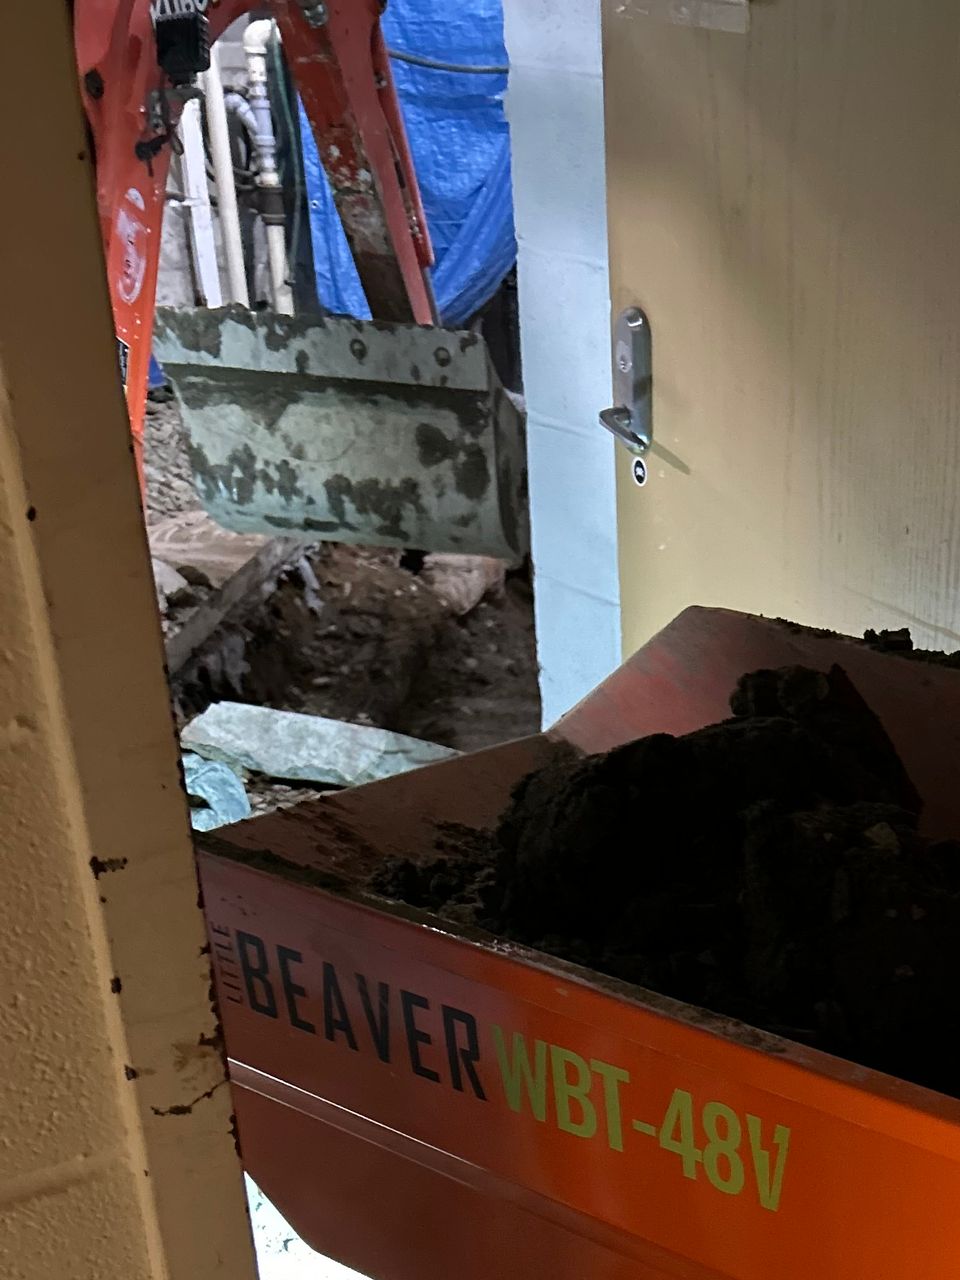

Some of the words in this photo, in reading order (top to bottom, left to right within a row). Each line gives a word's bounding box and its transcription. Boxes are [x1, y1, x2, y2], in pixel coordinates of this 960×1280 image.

[210, 920, 244, 1004] LITTLE
[235, 928, 488, 1102] BEAVER
[491, 1024, 791, 1212] WBT-48V
